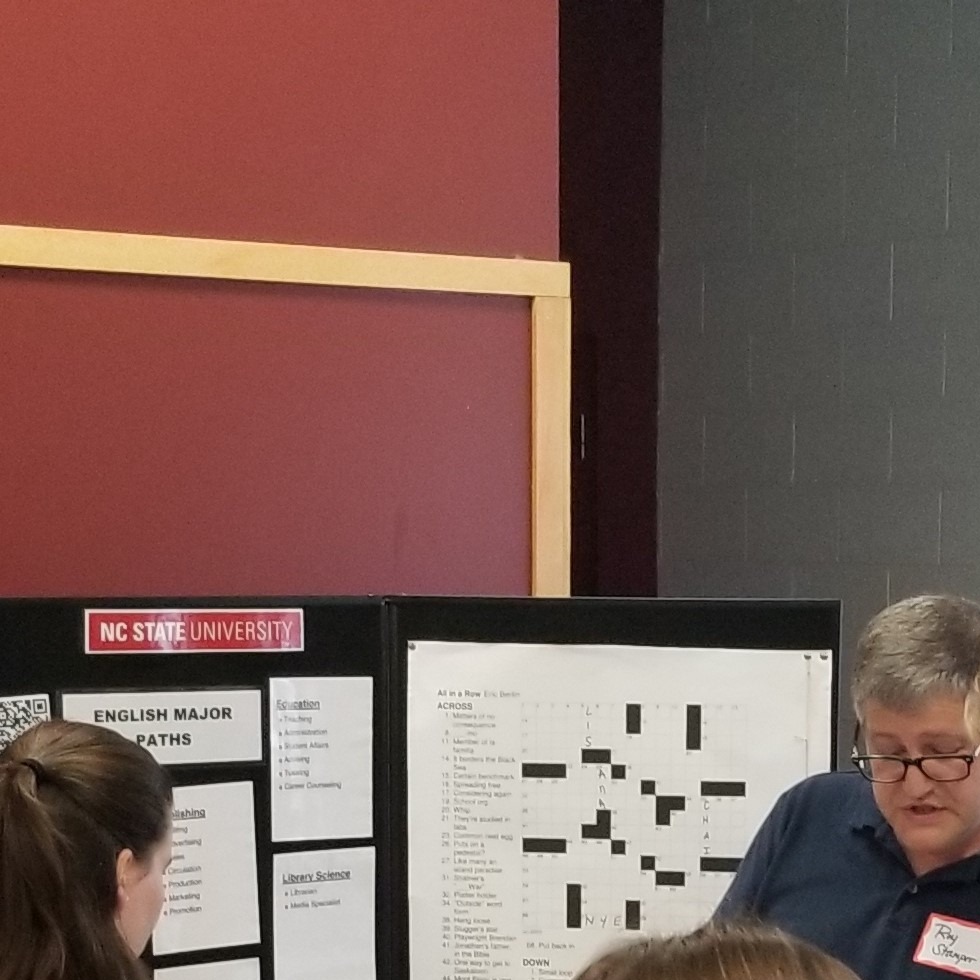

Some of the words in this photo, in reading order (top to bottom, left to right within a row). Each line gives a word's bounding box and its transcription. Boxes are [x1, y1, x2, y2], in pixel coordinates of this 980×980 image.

[100, 622, 127, 642] NC
[133, 621, 186, 642] STATE
[190, 621, 292, 641] UNIVERSITY
[464, 690, 481, 698] Row
[276, 699, 320, 711] Education
[437, 702, 473, 711] ACROSS
[94, 708, 168, 723] ENGLISH
[173, 706, 232, 721] MAJOR
[136, 733, 192, 747] PATHS
[282, 872, 314, 885] Library
[316, 870, 351, 882] Science
[168, 880, 202, 888] Production
[168, 893, 201, 901] Marketing
[169, 906, 202, 915] Promotion
[935, 923, 958, 946] Ray
[522, 958, 550, 967] DOWN
